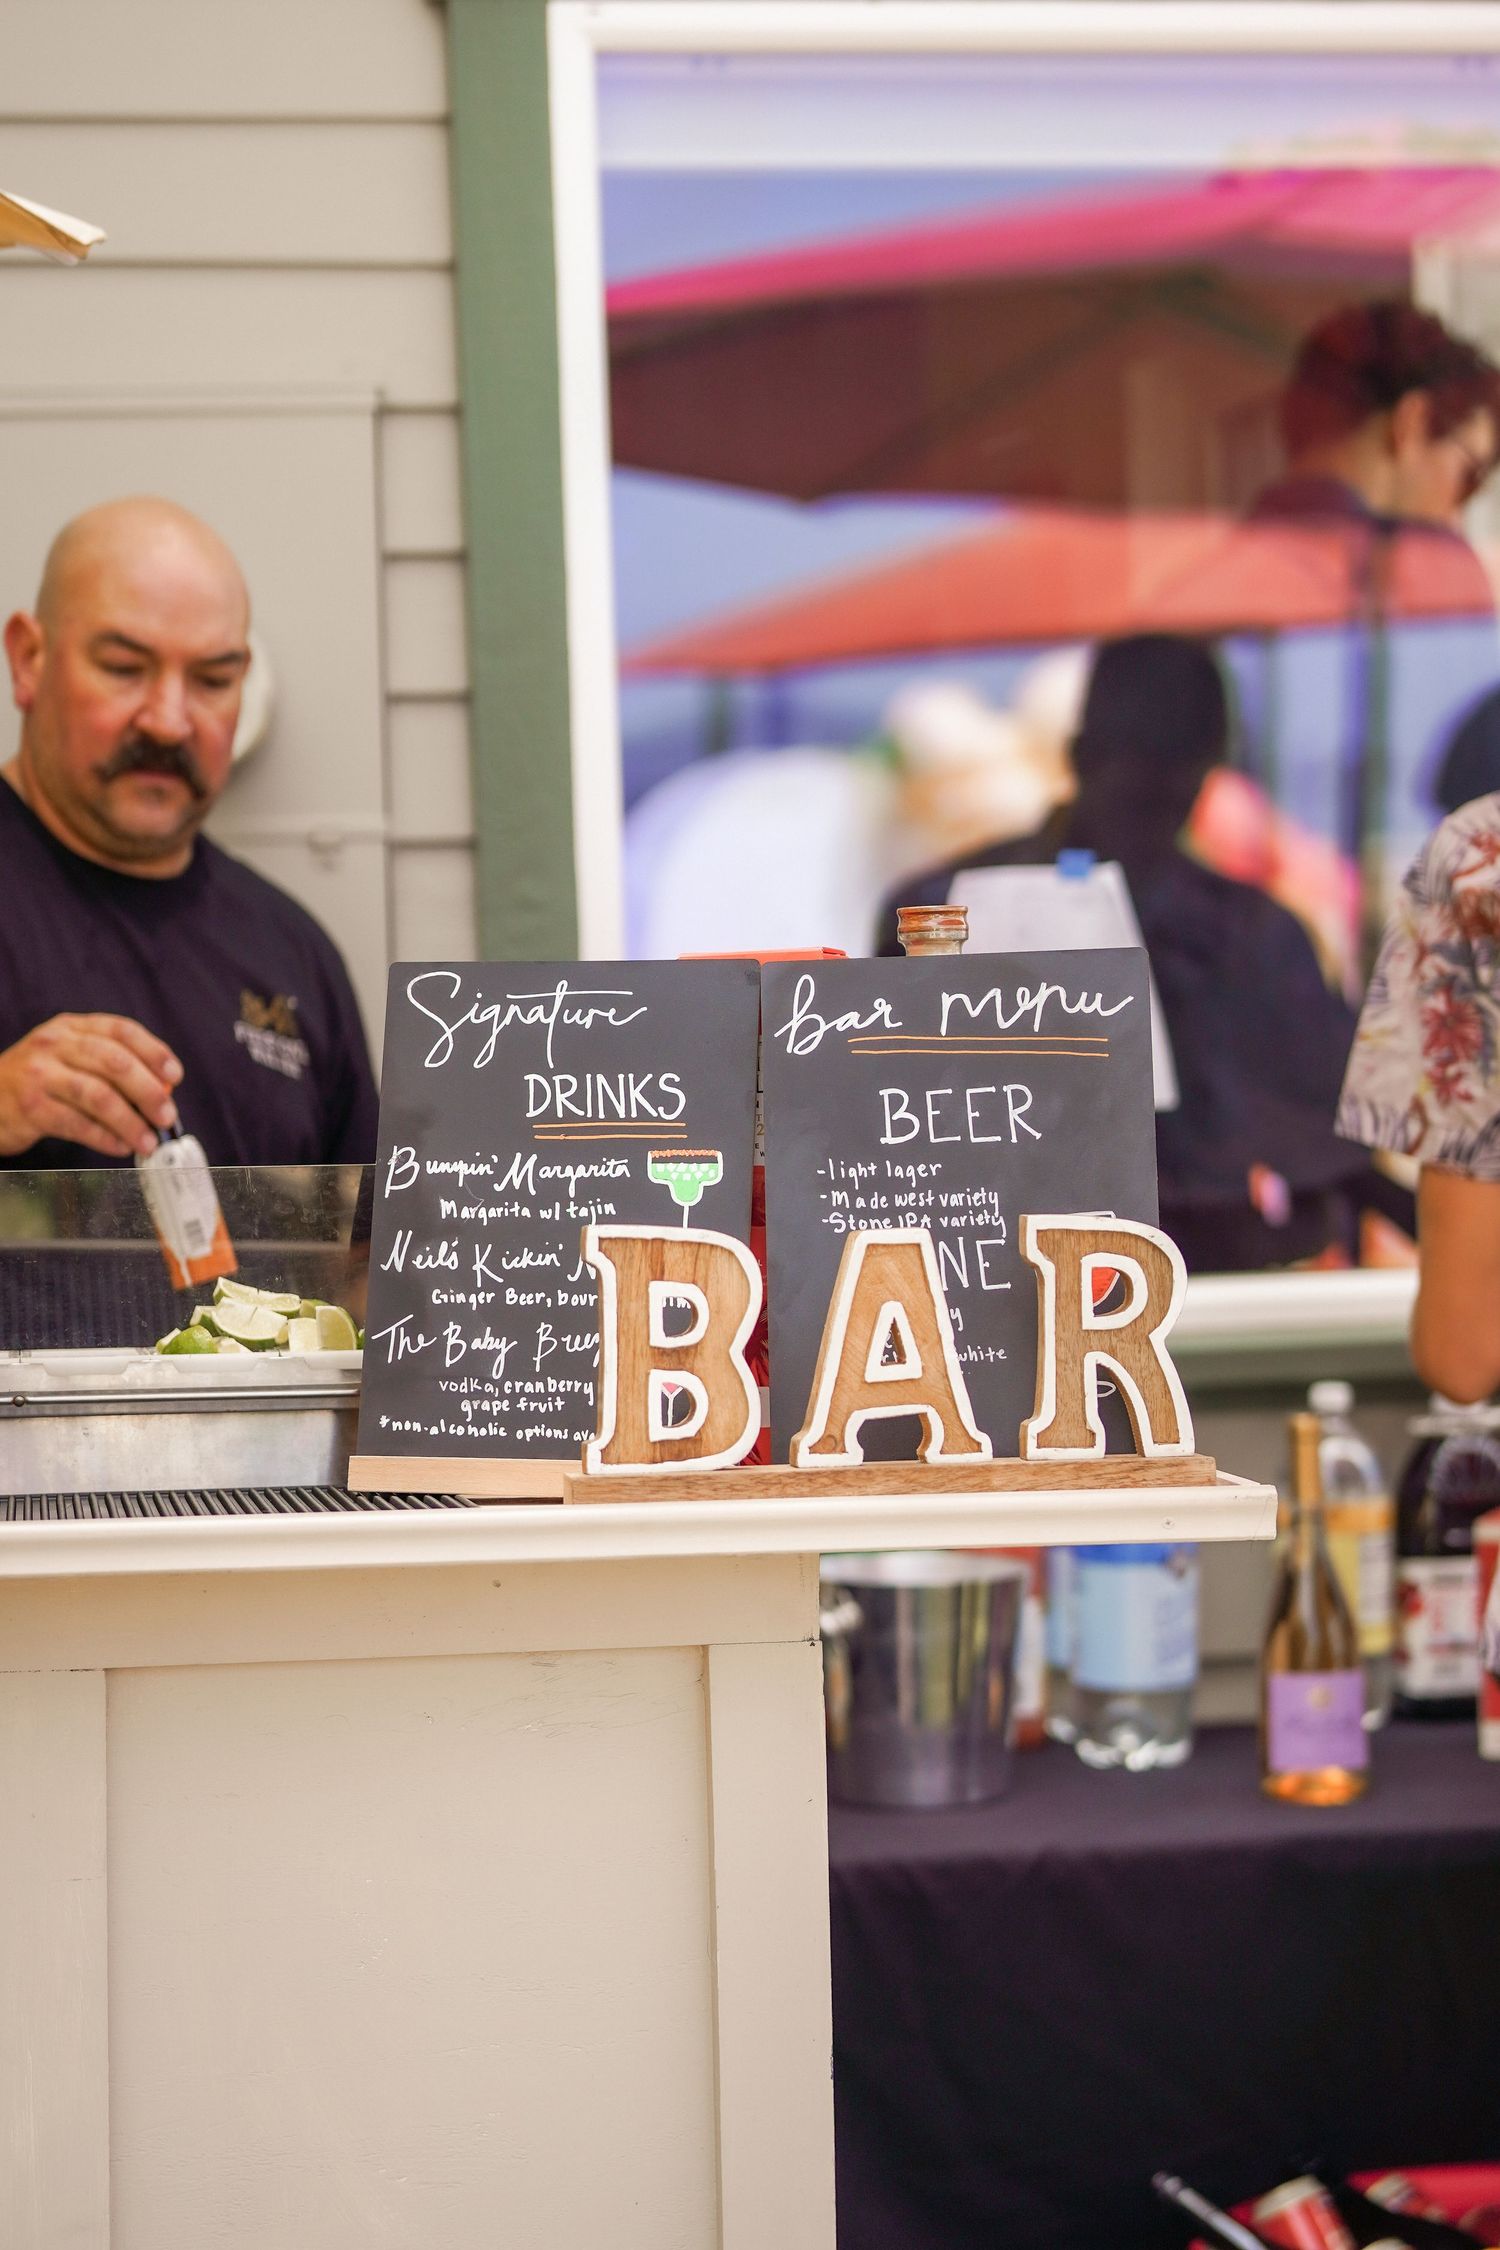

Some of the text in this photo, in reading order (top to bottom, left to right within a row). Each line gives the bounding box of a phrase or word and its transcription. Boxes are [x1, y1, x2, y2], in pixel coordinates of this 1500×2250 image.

[406, 971, 648, 1069] Signature
[773, 973, 1135, 1056] bar menu
[523, 1072, 687, 1121] DRINKS
[878, 1083, 1042, 1145] BEER
[493, 1151, 632, 1199] Margarita
[885, 1160, 943, 1188] lager
[439, 1199, 531, 1227] Margarita
[565, 1198, 618, 1227] tajin
[894, 1189, 935, 1208] west
[938, 1187, 1000, 1219] variety
[898, 1211, 933, 1229] IPA
[938, 1209, 1007, 1239] variety
[380, 1229, 460, 1274] Neil's
[471, 1242, 564, 1288] Kickin'
[431, 1287, 599, 1311] Ginger Beer, bour
[371, 1313, 438, 1364] The
[442, 1320, 518, 1380] Baby
[579, 1212, 1196, 1477] BAR
[438, 1376, 594, 1406] vodka, cranberry
[460, 1396, 566, 1422] grape fruit
[515, 1423, 569, 1442] options
